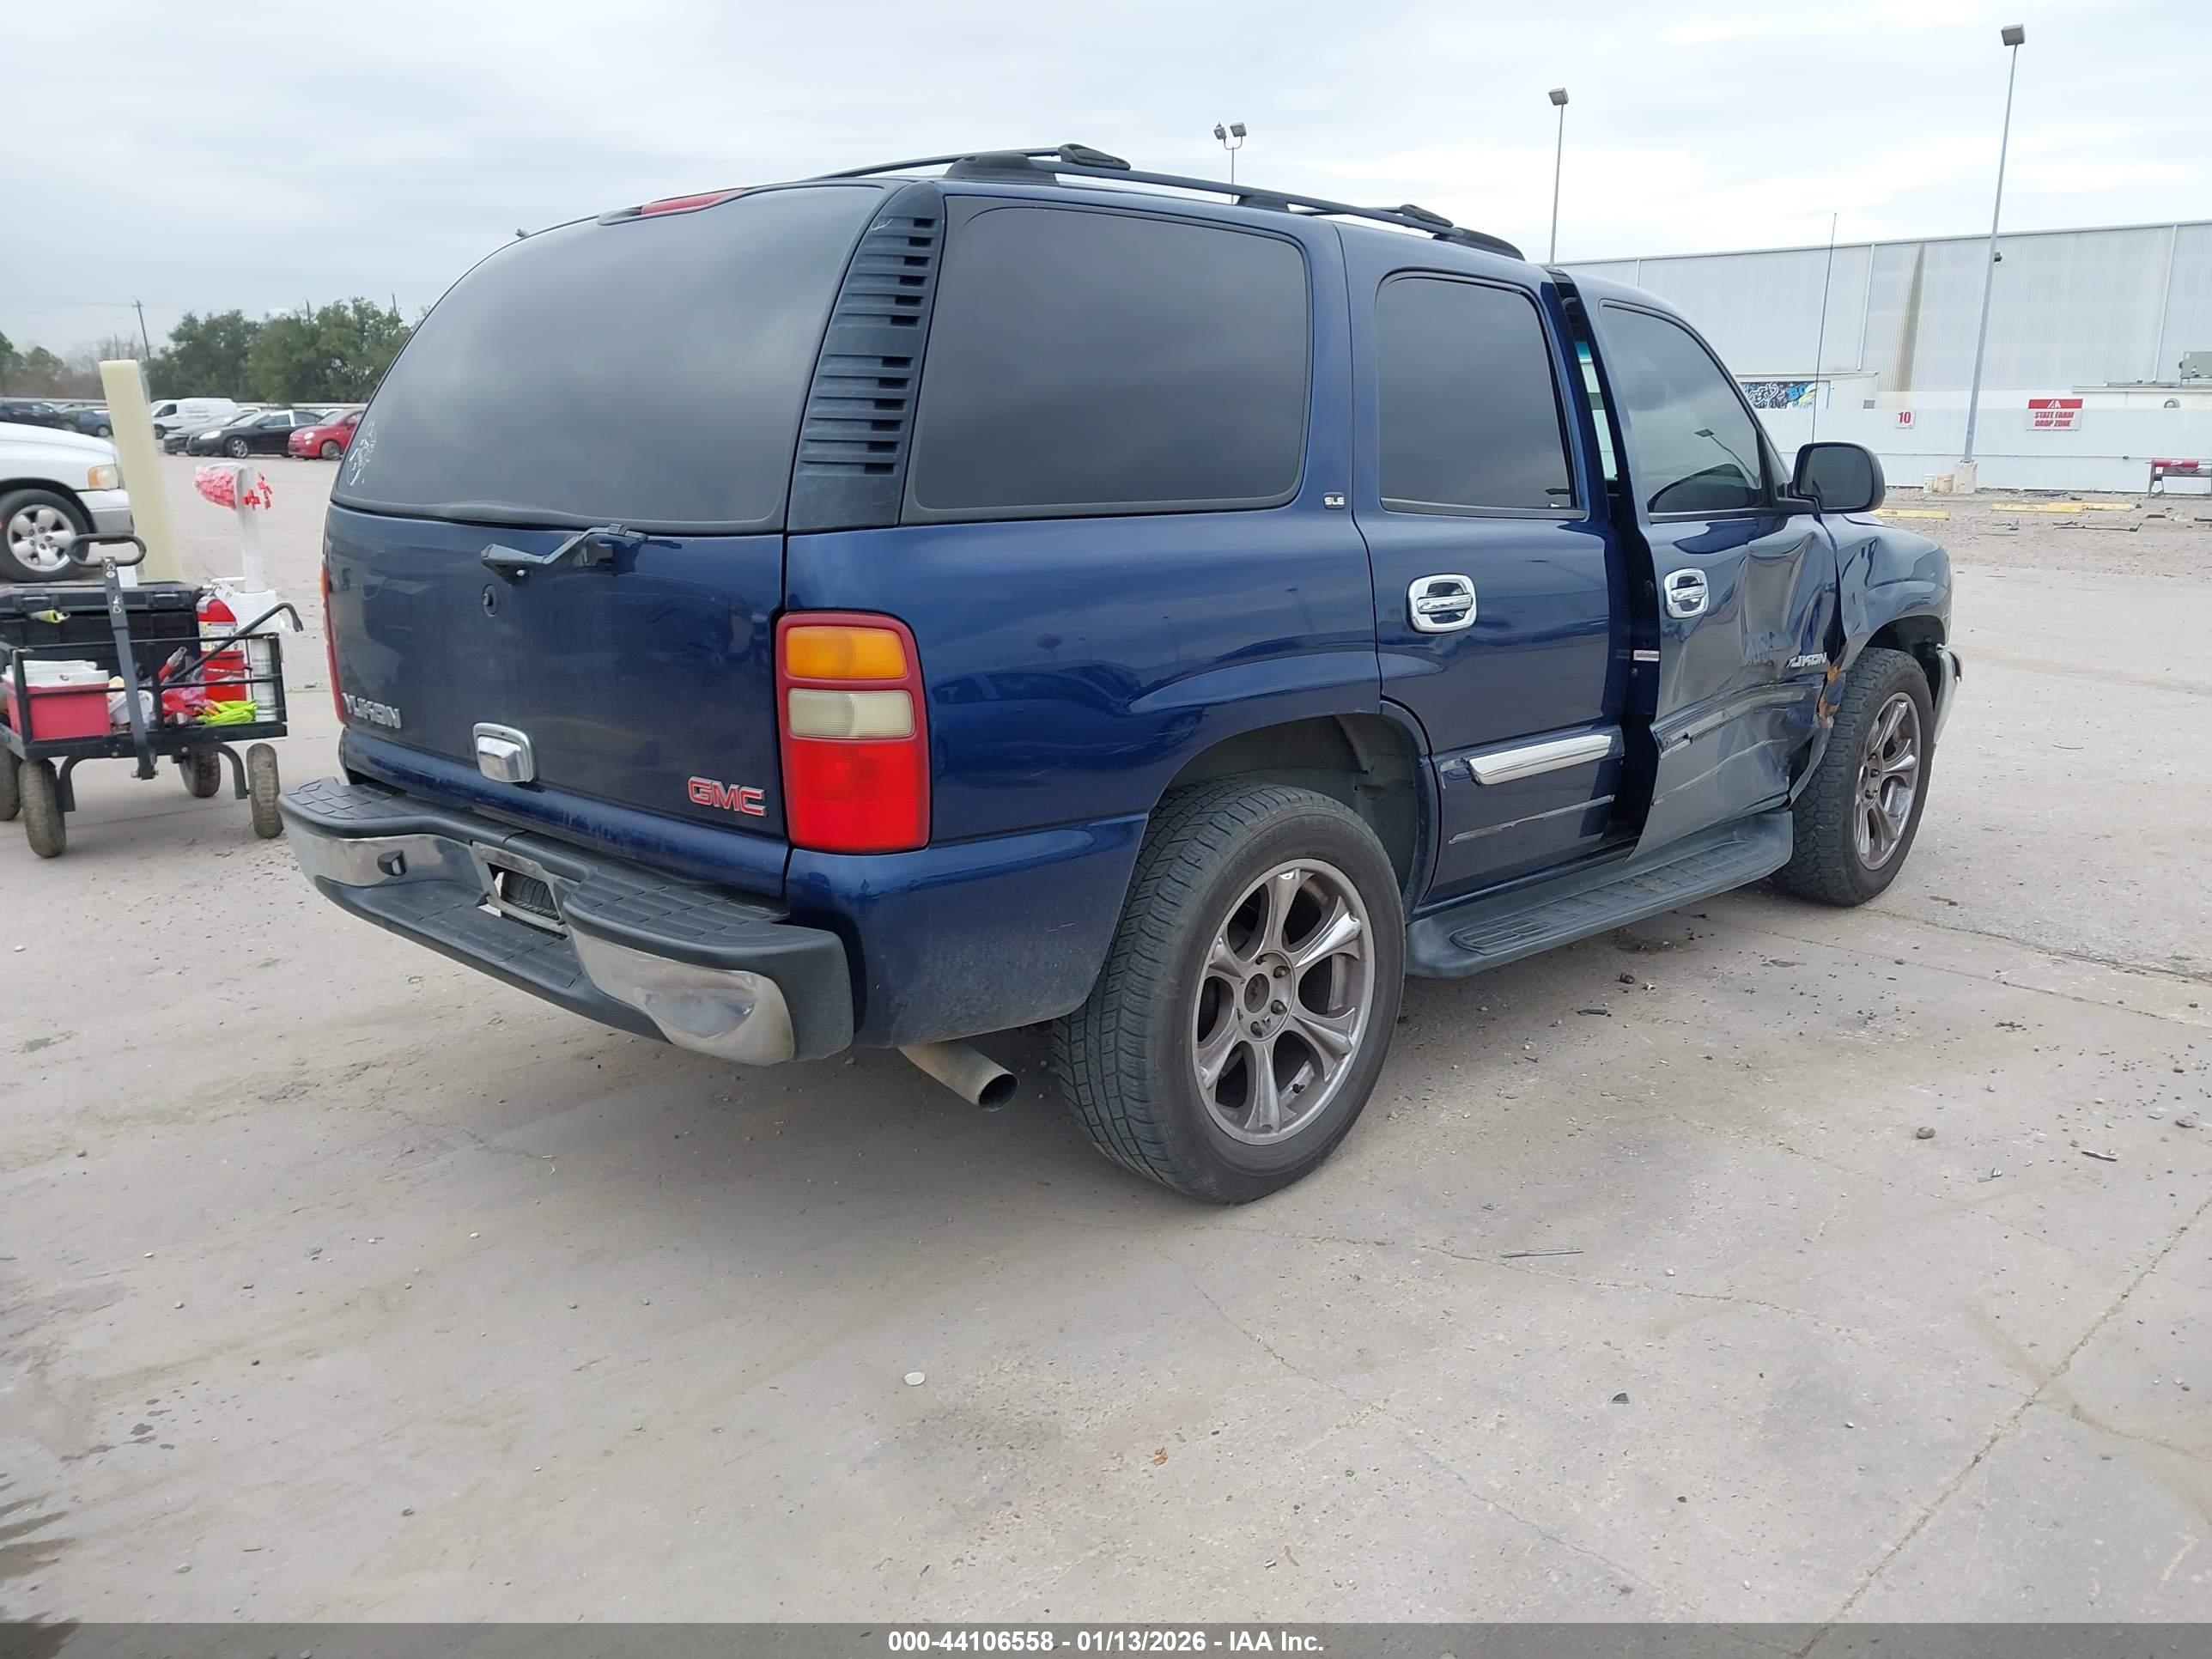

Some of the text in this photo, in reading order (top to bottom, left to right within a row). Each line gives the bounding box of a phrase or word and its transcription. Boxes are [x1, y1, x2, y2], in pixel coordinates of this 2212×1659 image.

[1898, 411, 1911, 424] 10
[1324, 496, 1345, 506] SLE
[1786, 653, 1827, 668] YUKON
[341, 692, 403, 729] YUKON
[688, 776, 767, 817] GMC
